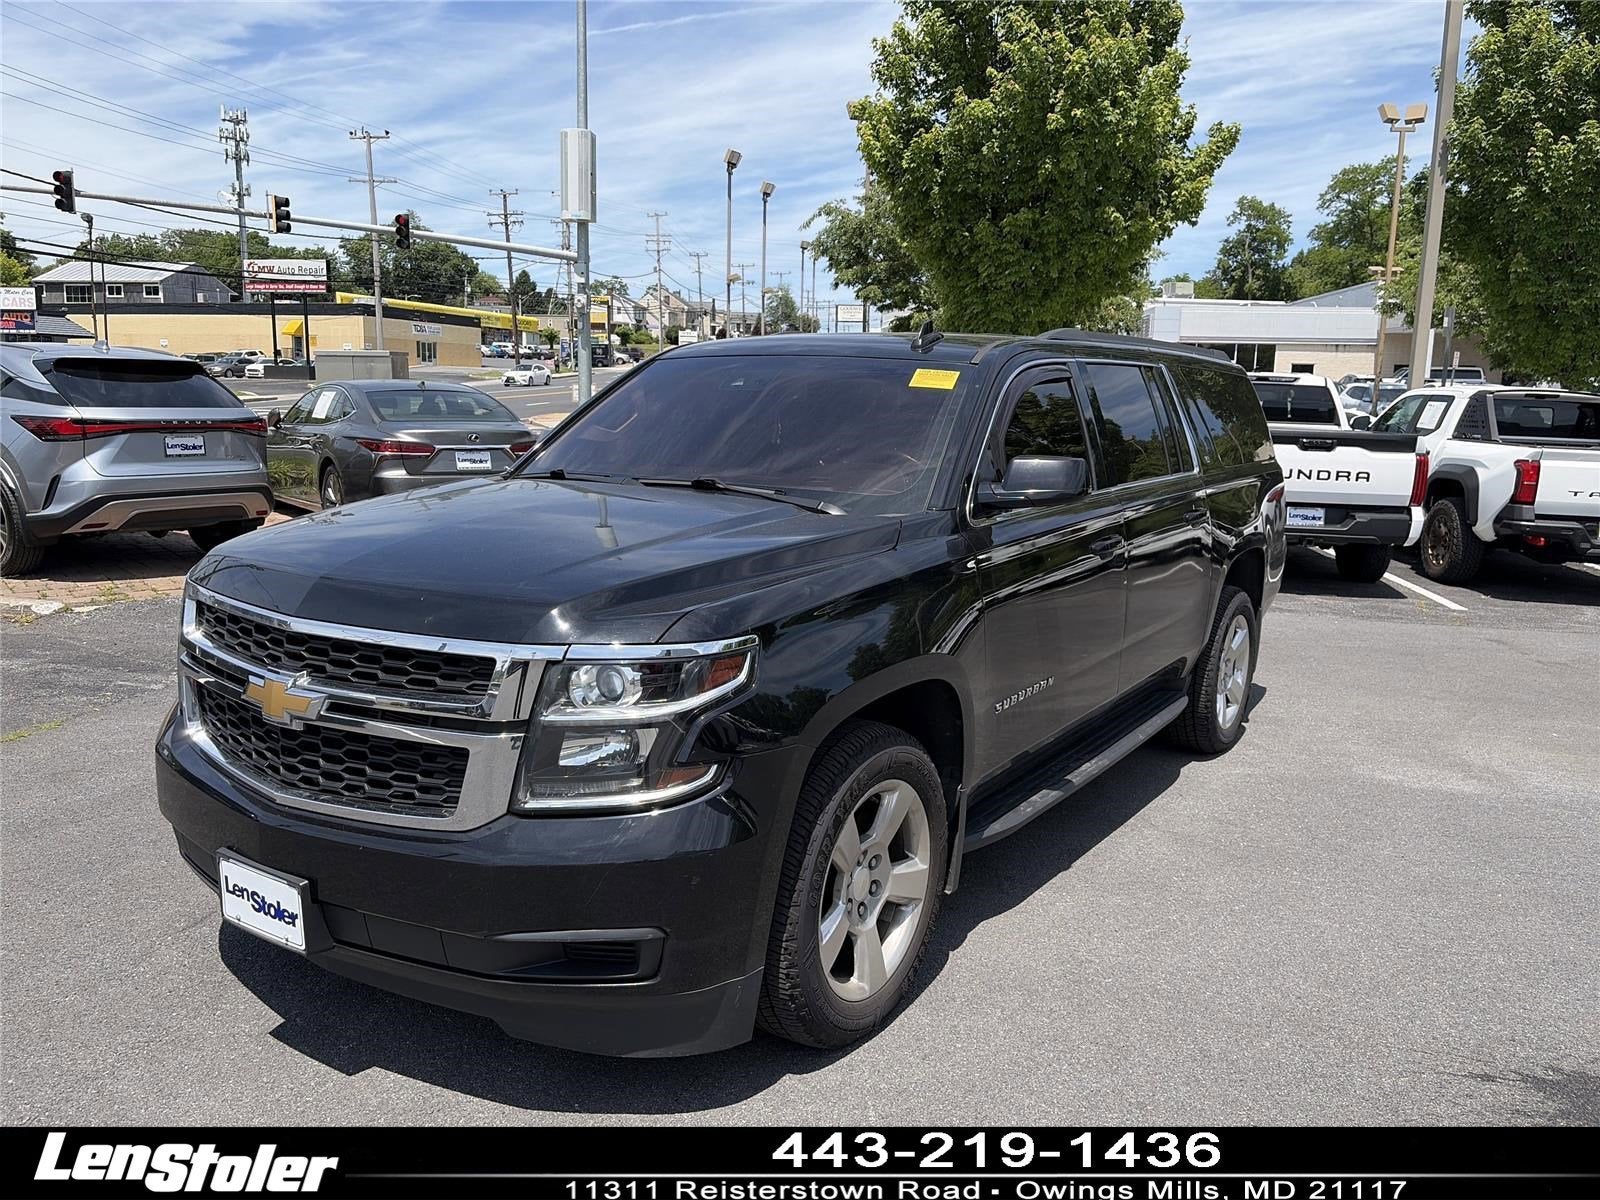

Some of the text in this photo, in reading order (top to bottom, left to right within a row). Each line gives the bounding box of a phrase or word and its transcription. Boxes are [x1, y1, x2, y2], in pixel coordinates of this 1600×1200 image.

[277, 265, 296, 274] Auto
[298, 265, 325, 275] Repair
[2, 296, 34, 308] CARS
[3, 312, 31, 321] AUTO
[166, 442, 203, 451] LenStoler
[995, 676, 1055, 714] SUBURBAN
[224, 874, 299, 928] LenStoler
